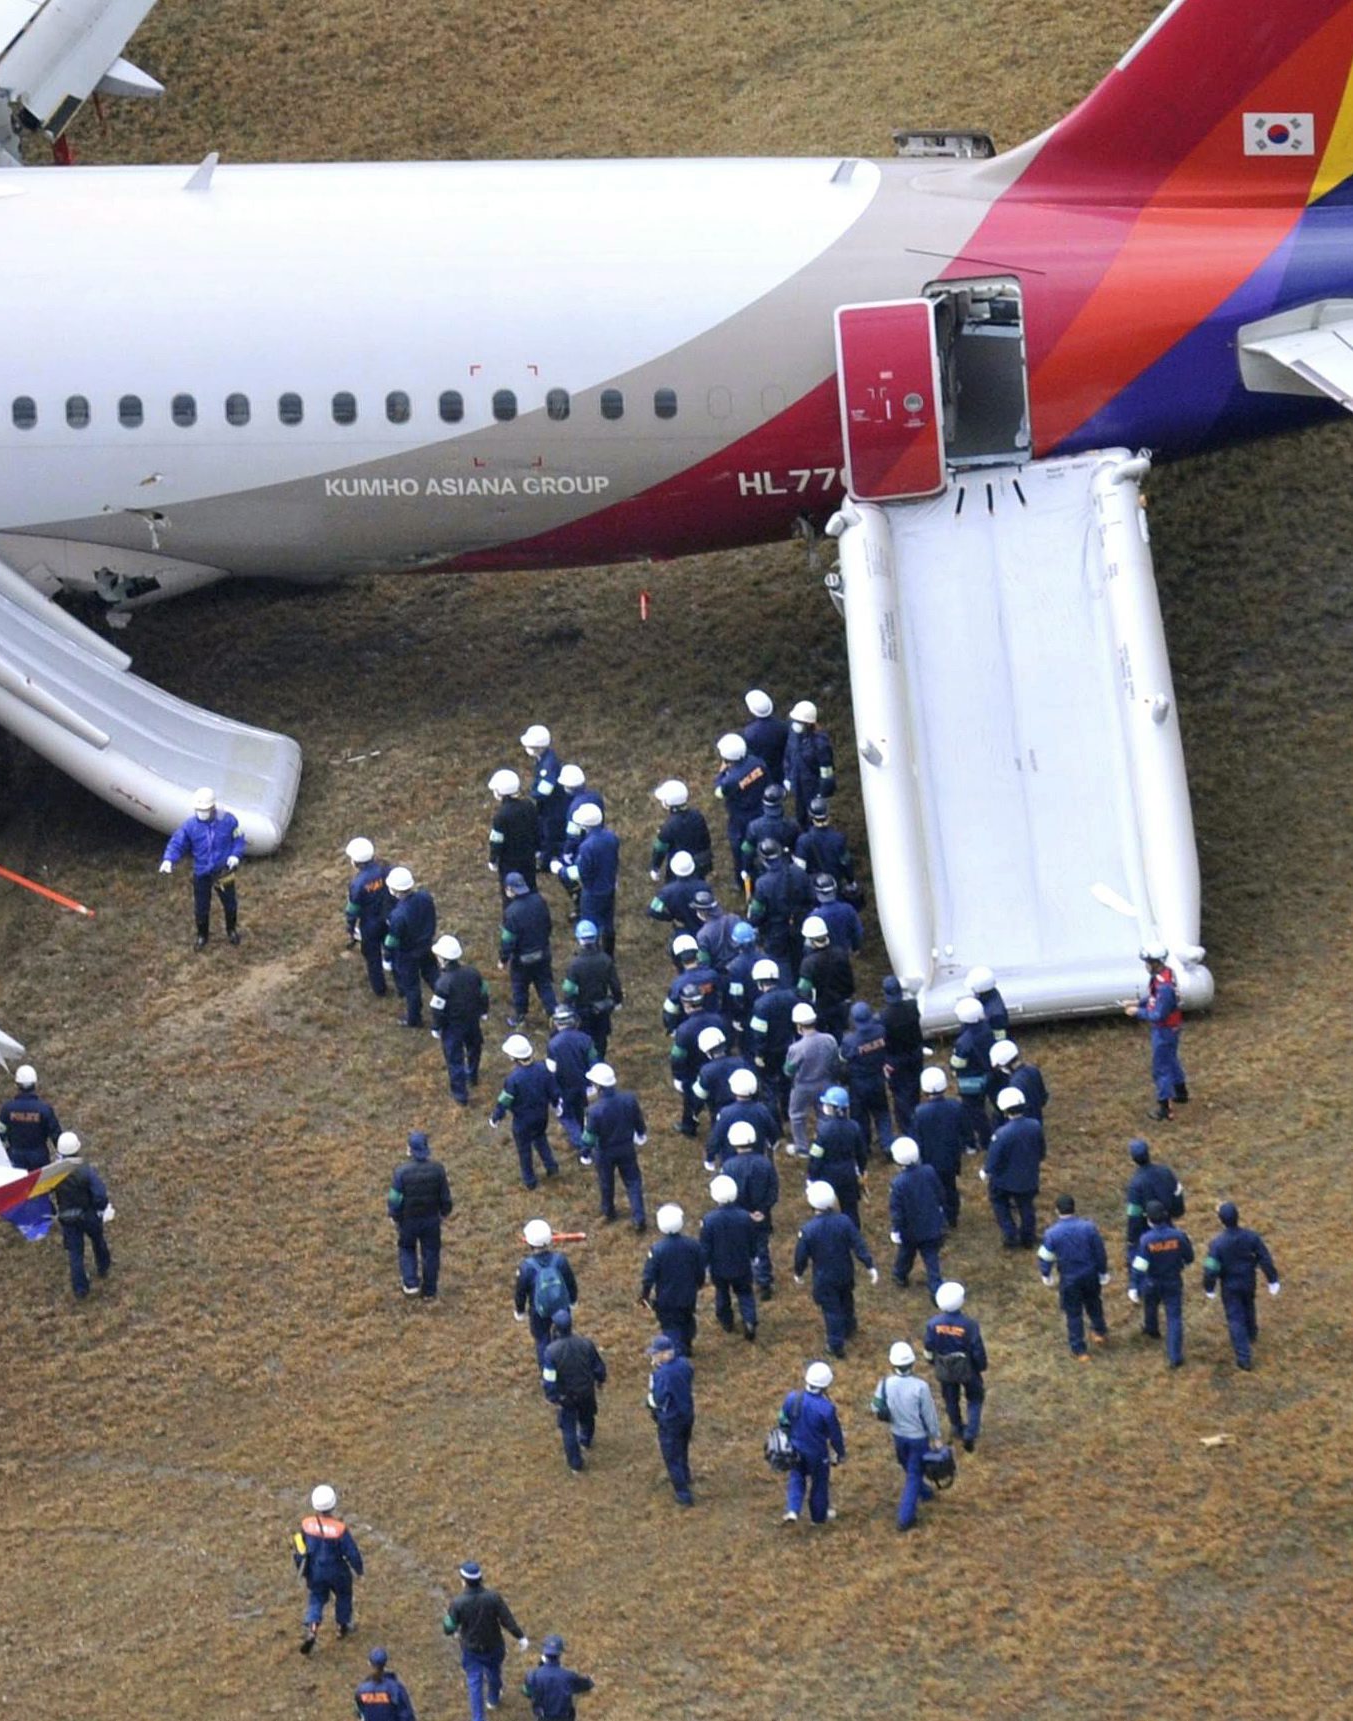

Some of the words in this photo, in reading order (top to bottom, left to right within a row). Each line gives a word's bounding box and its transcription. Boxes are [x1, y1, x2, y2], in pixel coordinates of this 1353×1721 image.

[324, 478, 420, 497] KUMHO
[425, 477, 517, 496] ASIANA
[522, 476, 610, 495] GROUP
[9, 1111, 41, 1123] POLICE
